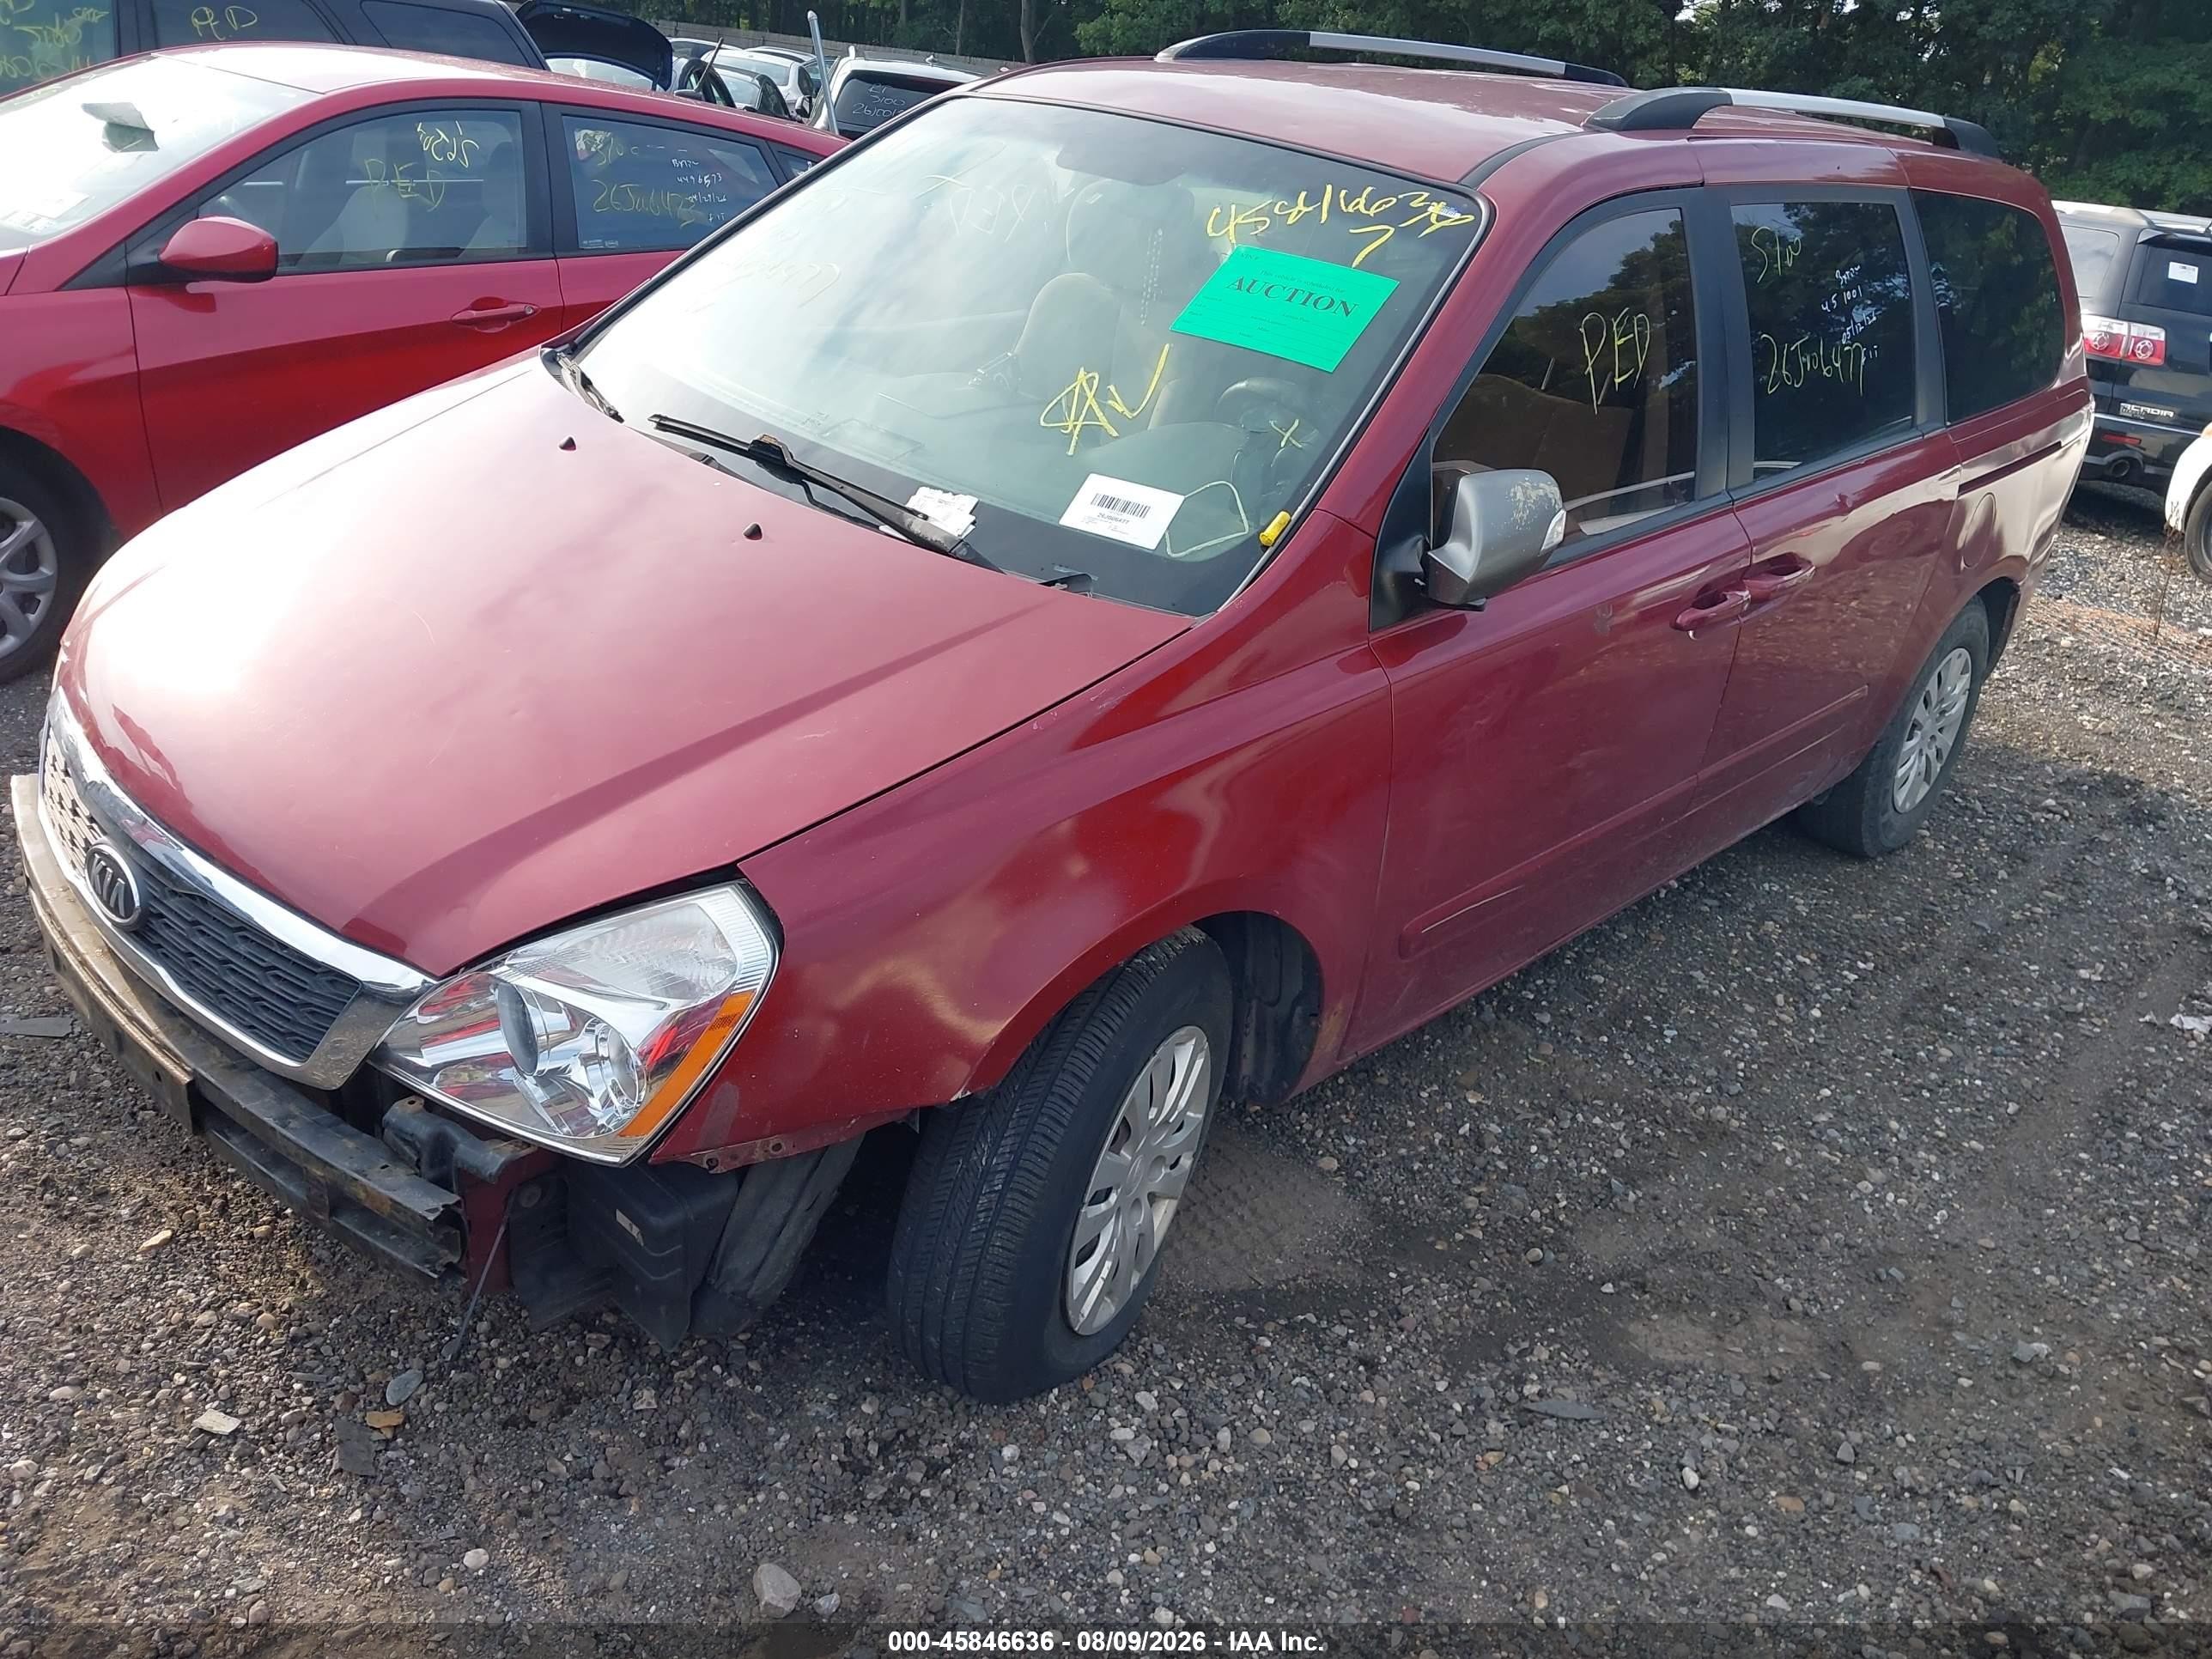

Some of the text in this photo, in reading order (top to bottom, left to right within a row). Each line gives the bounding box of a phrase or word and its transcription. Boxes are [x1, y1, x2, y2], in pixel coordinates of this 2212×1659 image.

[1225, 276, 1360, 318] AUCTION
[1579, 307, 1650, 415] PED
[2120, 403, 2175, 417] ACADIA
[90, 853, 126, 918] KIA
